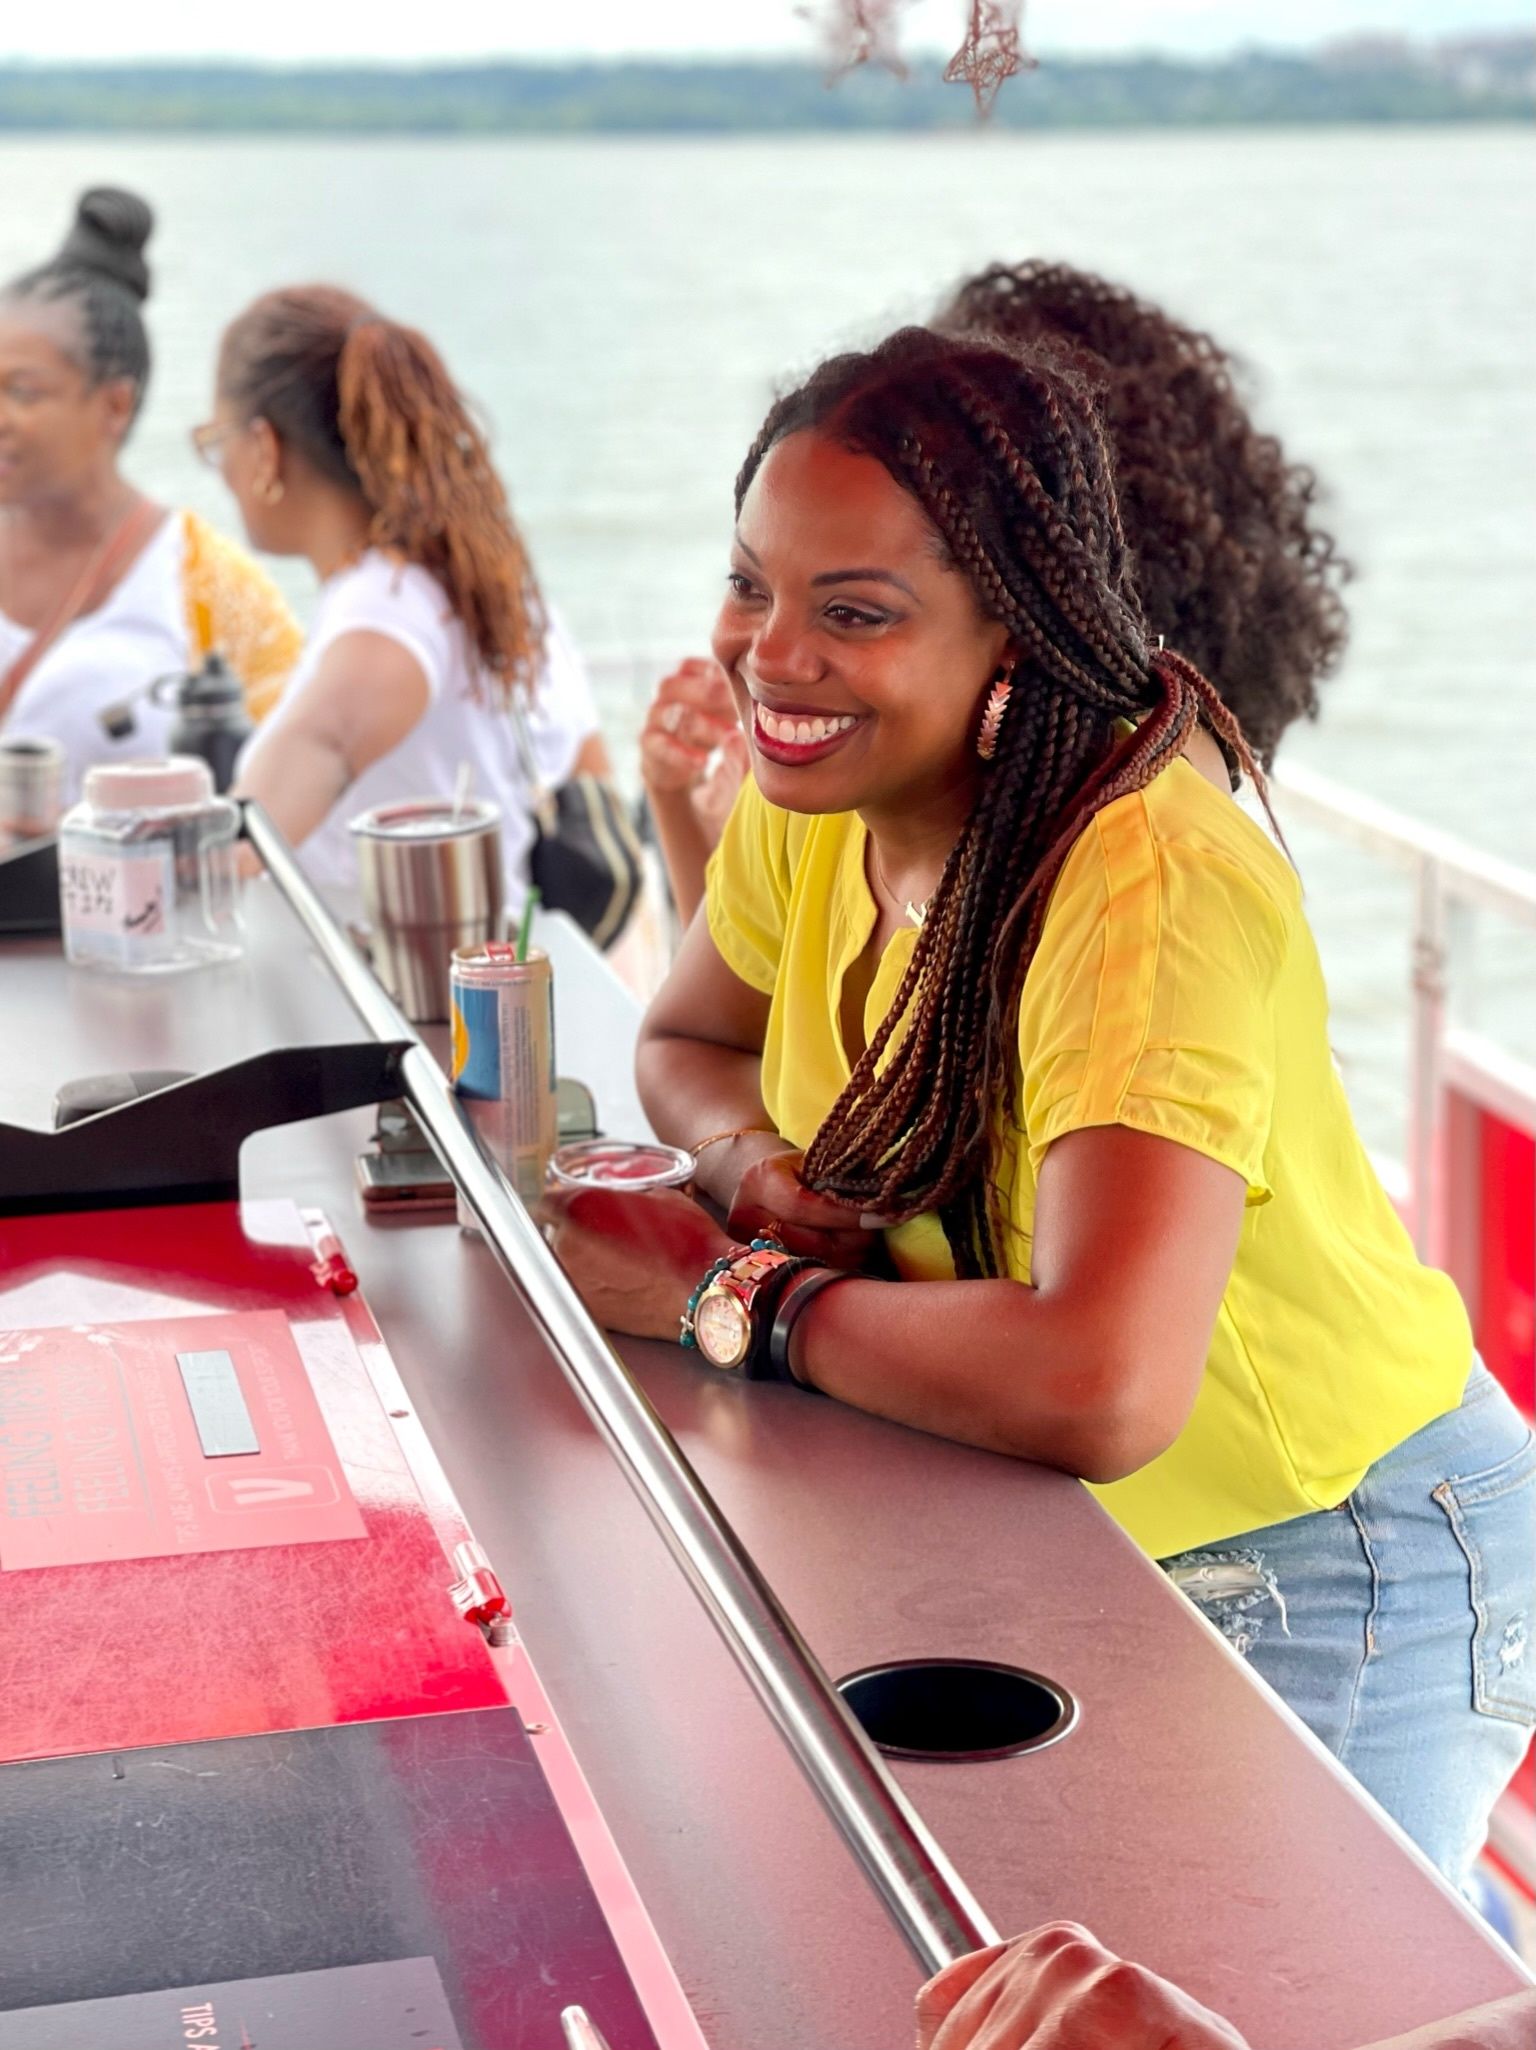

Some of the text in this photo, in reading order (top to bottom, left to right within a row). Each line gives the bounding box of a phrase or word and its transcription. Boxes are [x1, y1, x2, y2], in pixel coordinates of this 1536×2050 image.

[0, 1428, 63, 1519] FEELING
[64, 1427, 132, 1513] FEELING
[180, 2001, 218, 2039] TIPS
